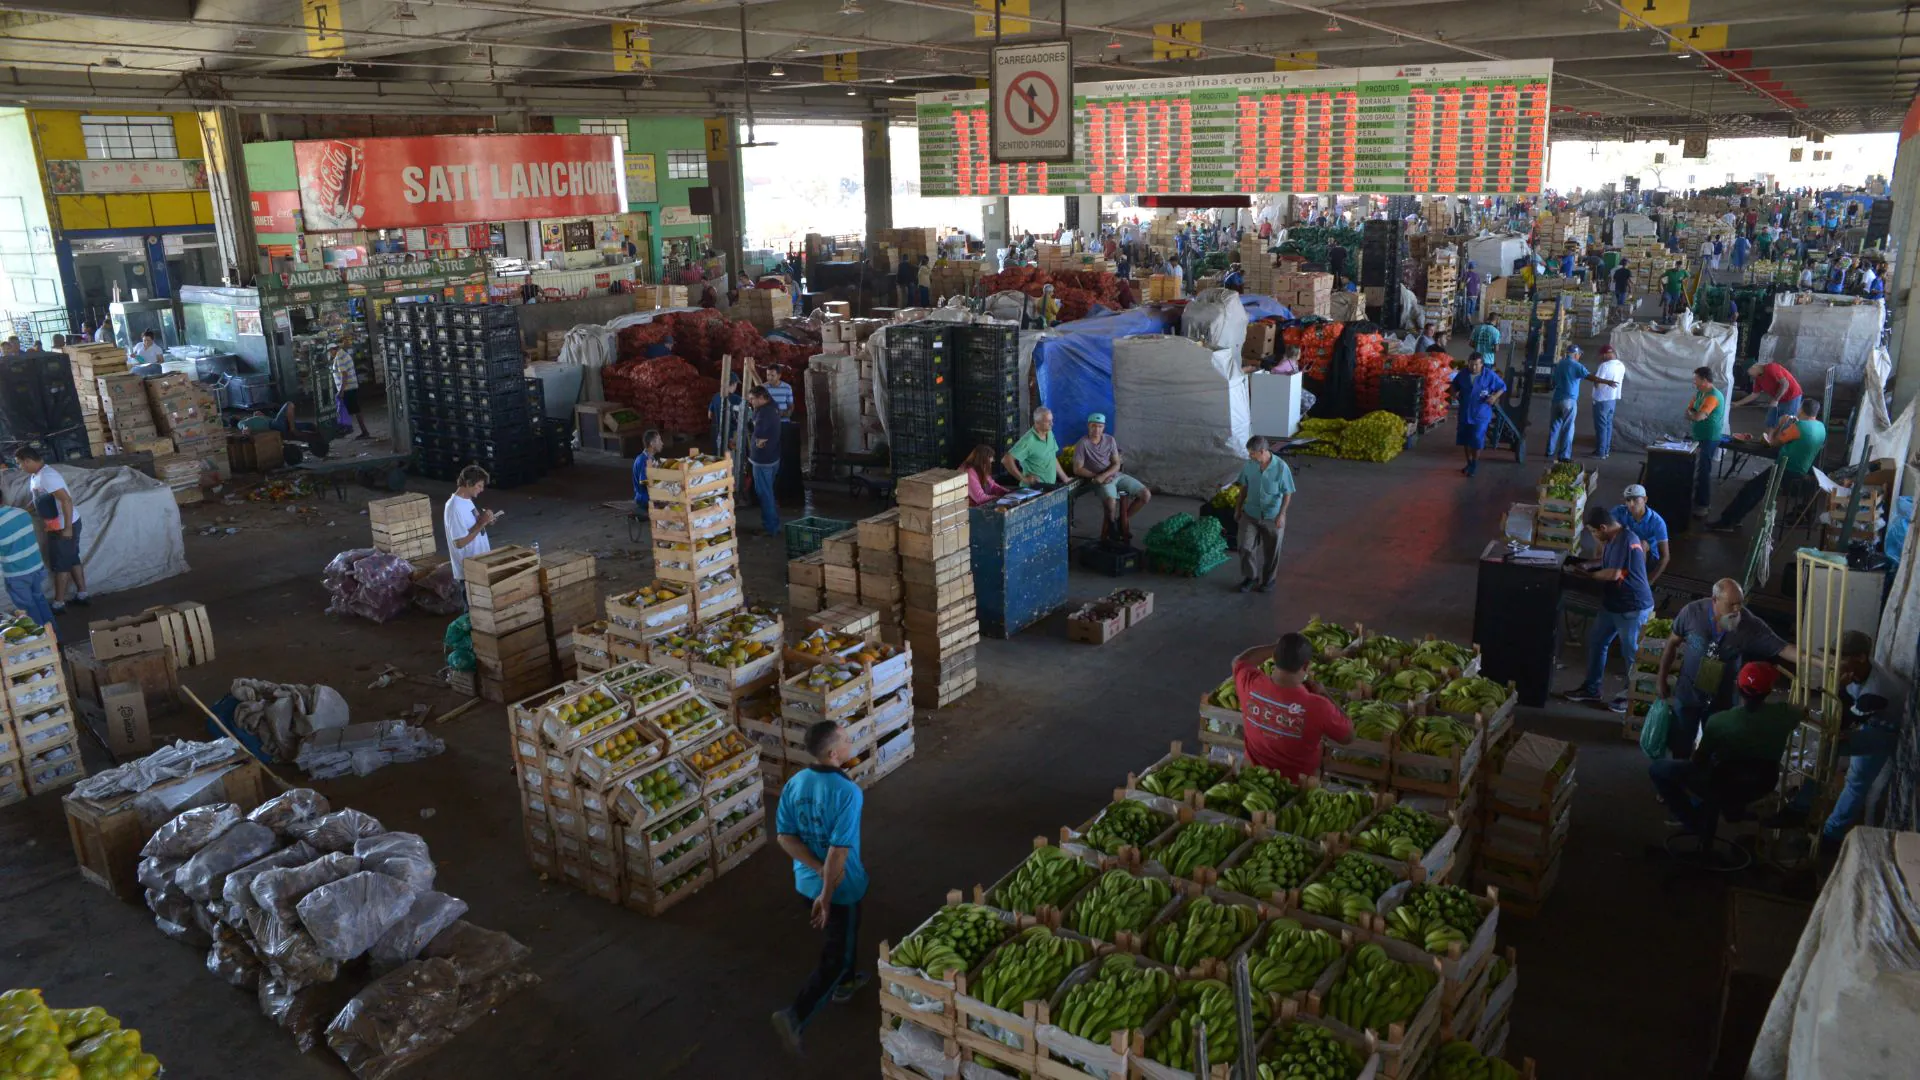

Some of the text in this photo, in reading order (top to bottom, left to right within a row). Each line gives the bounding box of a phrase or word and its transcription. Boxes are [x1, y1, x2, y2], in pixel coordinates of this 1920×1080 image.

[314, 5, 328, 40] F
[998, 52, 1066, 65] CARREGADORES
[1104, 75, 1288, 92] www.ceasaminas.com.br
[1366, 84, 1400, 92] PRODUTOS
[711, 128, 721, 150] F
[998, 140, 1066, 149] SENTIDO PROIBIDO
[401, 160, 617, 204] SATI LANCHONE
[286, 272, 323, 287] ANCA
